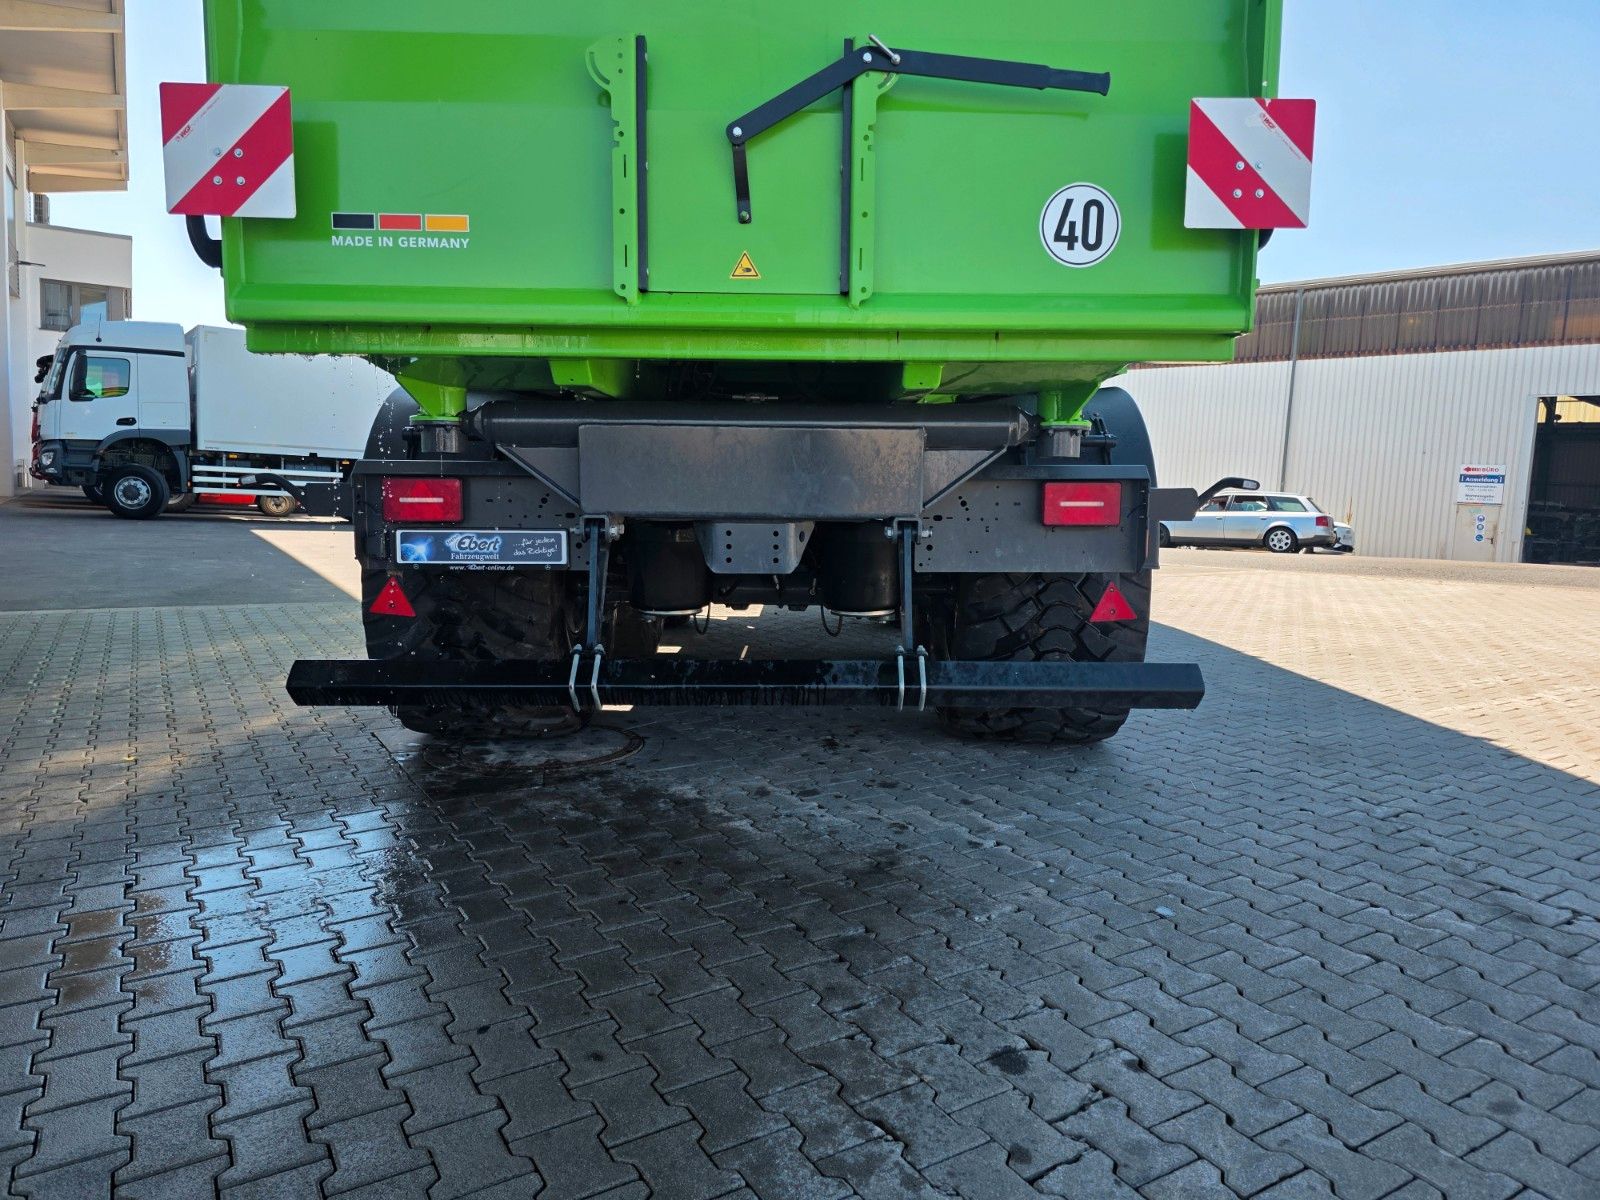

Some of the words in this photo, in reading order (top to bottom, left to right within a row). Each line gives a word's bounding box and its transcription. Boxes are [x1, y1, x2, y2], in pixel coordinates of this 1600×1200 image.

[1053, 198, 1105, 252] 40
[331, 235, 374, 247] MADE
[378, 236, 393, 247] IN
[398, 236, 470, 249] GERMANY
[456, 534, 502, 552] Ebert
[450, 552, 499, 562] Fahrzeugwelt
